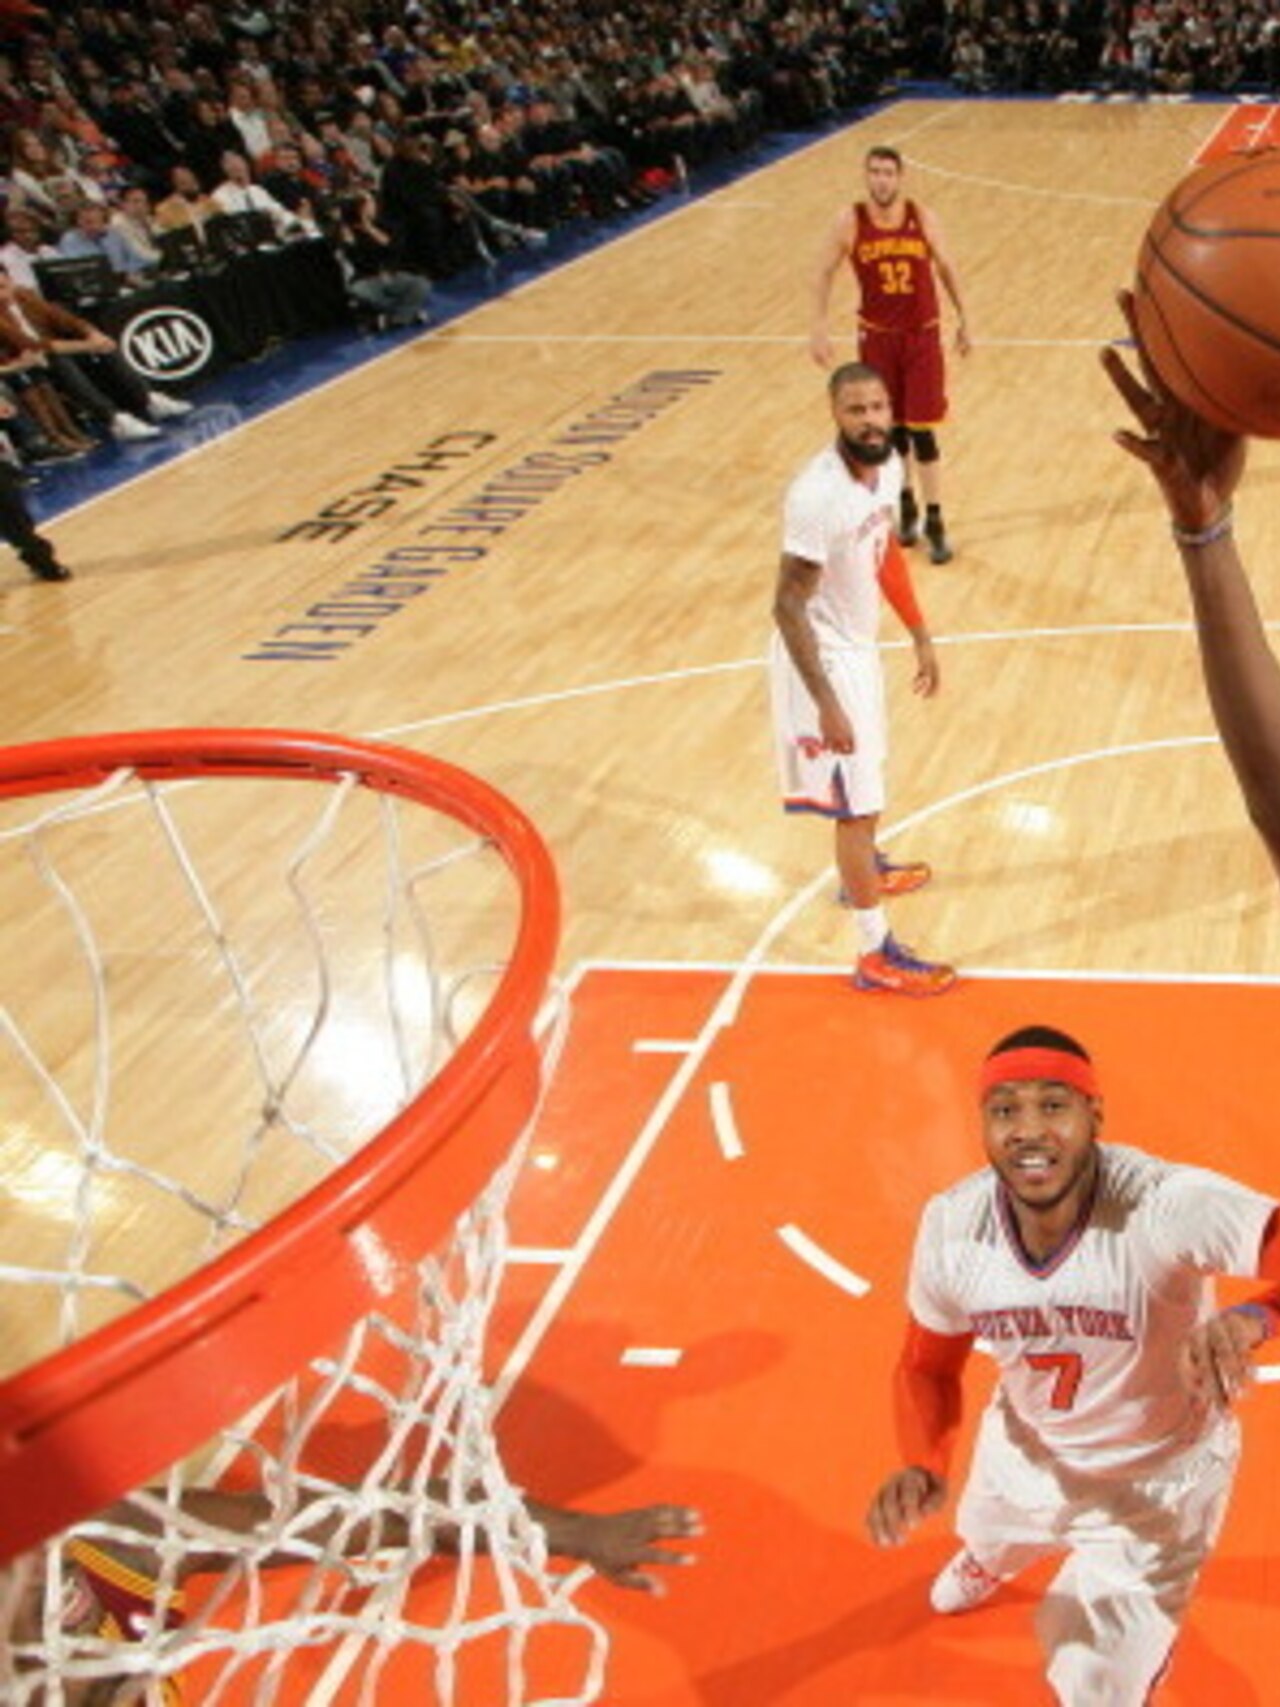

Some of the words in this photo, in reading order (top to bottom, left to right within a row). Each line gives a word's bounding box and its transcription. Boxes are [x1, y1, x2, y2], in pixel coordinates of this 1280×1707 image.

[878, 261, 915, 294] 32
[132, 320, 205, 368] KIA
[554, 369, 726, 445] MADISON
[273, 430, 497, 544] CHASE
[417, 451, 612, 536] SQUARE
[241, 546, 489, 661] GARDEN
[1023, 1353, 1083, 1411] 7
